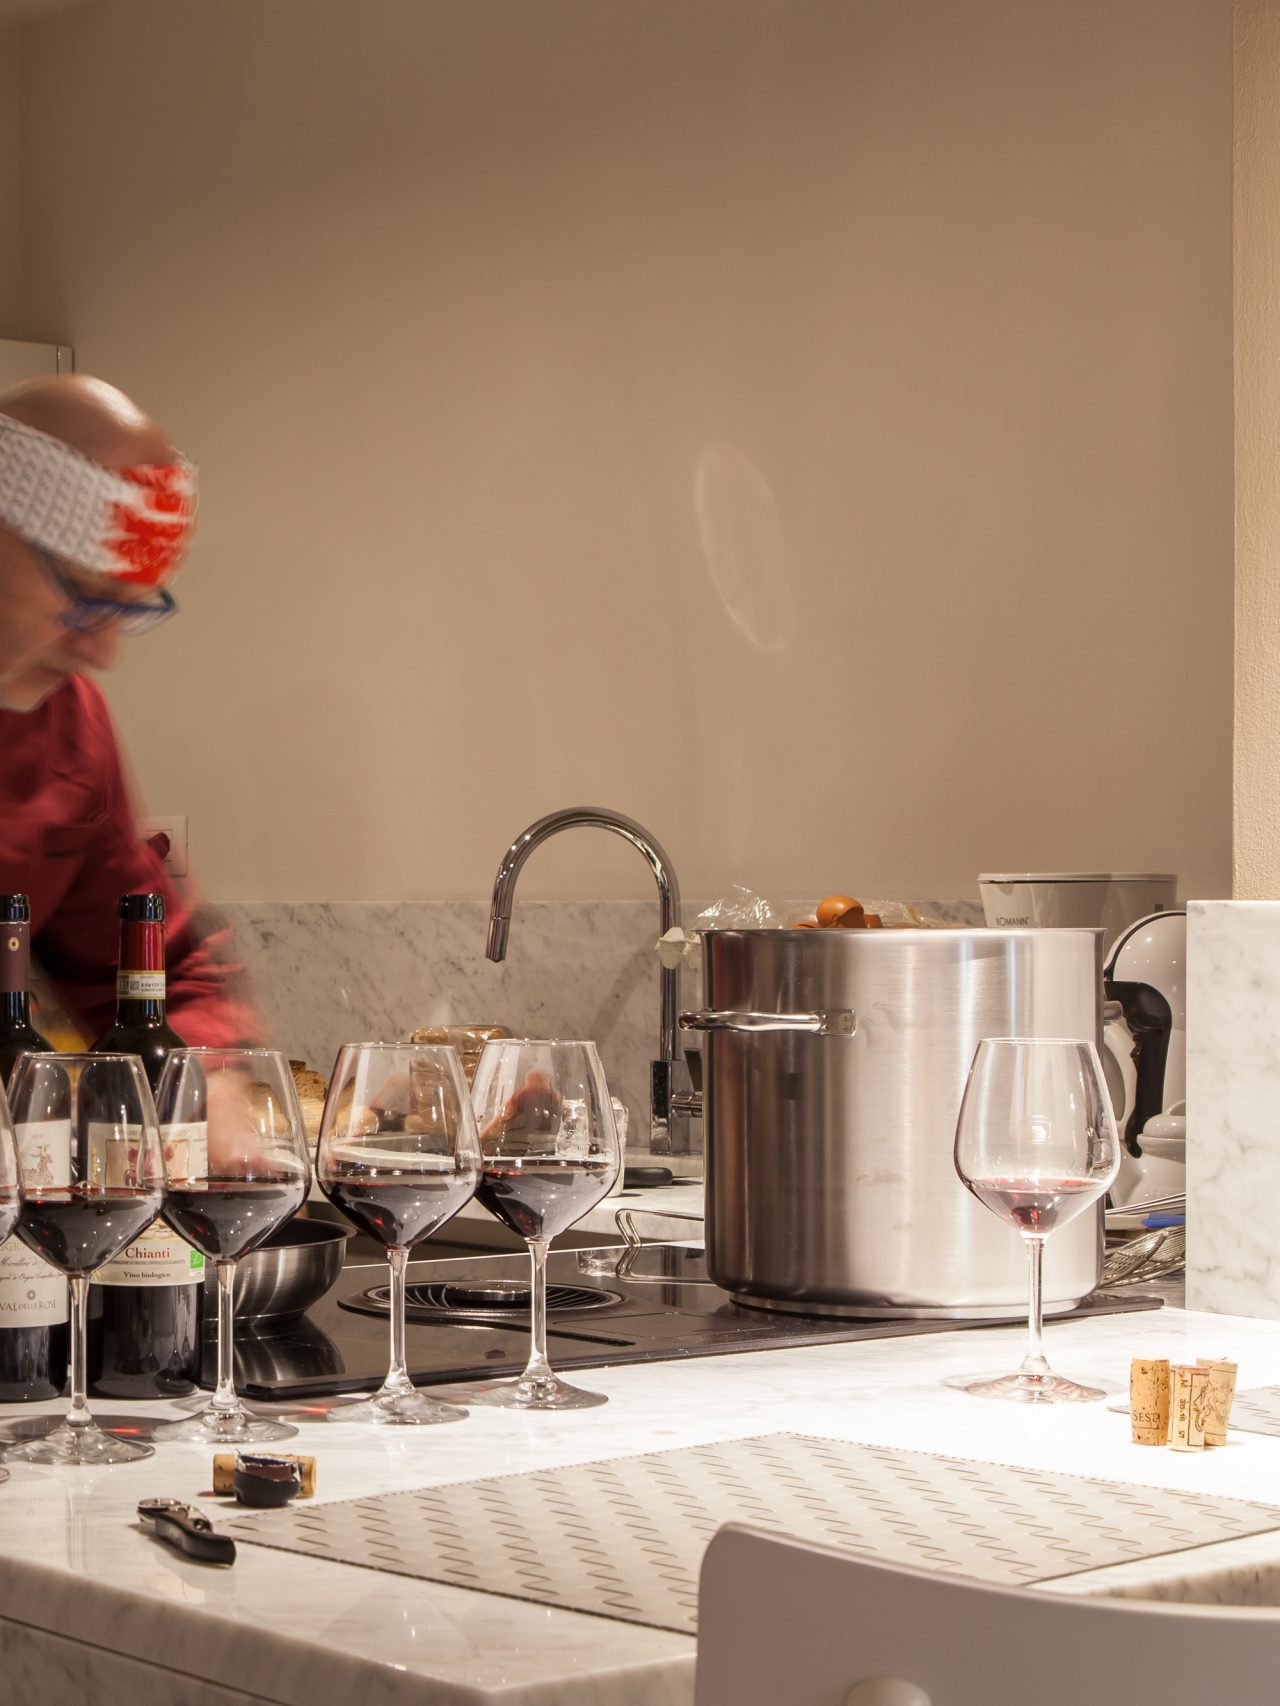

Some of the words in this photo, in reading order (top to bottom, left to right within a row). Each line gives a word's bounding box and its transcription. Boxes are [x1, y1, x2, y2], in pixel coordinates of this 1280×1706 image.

[125, 1247, 170, 1259] Chianti
[141, 1271, 171, 1280] biologico
[0, 1302, 18, 1312] VAL
[1132, 1409, 1161, 1423] SESTA
